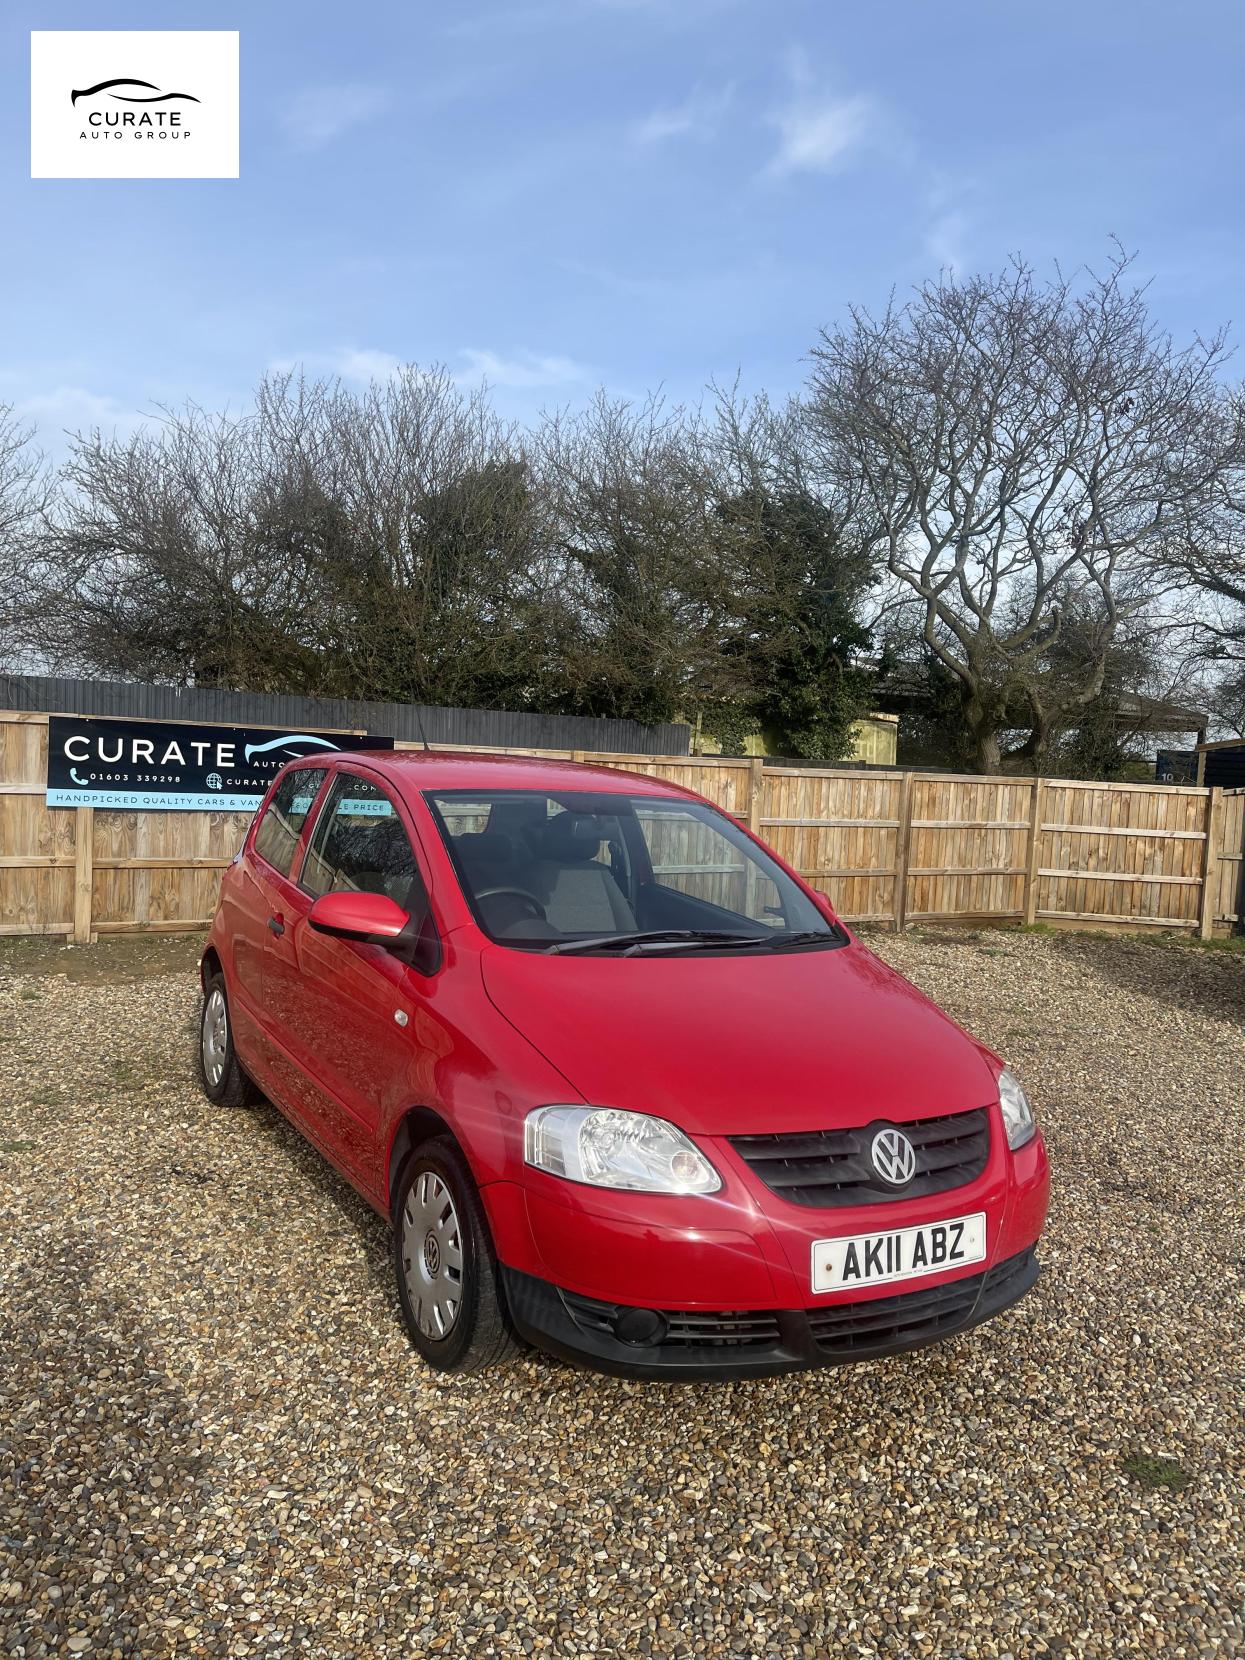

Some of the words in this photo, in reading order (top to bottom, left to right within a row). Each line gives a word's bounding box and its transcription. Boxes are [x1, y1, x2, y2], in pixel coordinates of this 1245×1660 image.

[63, 735, 236, 768] CURATE
[90, 773, 129, 781] 01603
[136, 774, 181, 783] 339298
[56, 794, 138, 804] HANDPICKED
[142, 797, 193, 805] QUALITY
[197, 798, 225, 806] CARS
[842, 1235, 901, 1281] AK11
[912, 1222, 965, 1269] ABZ
